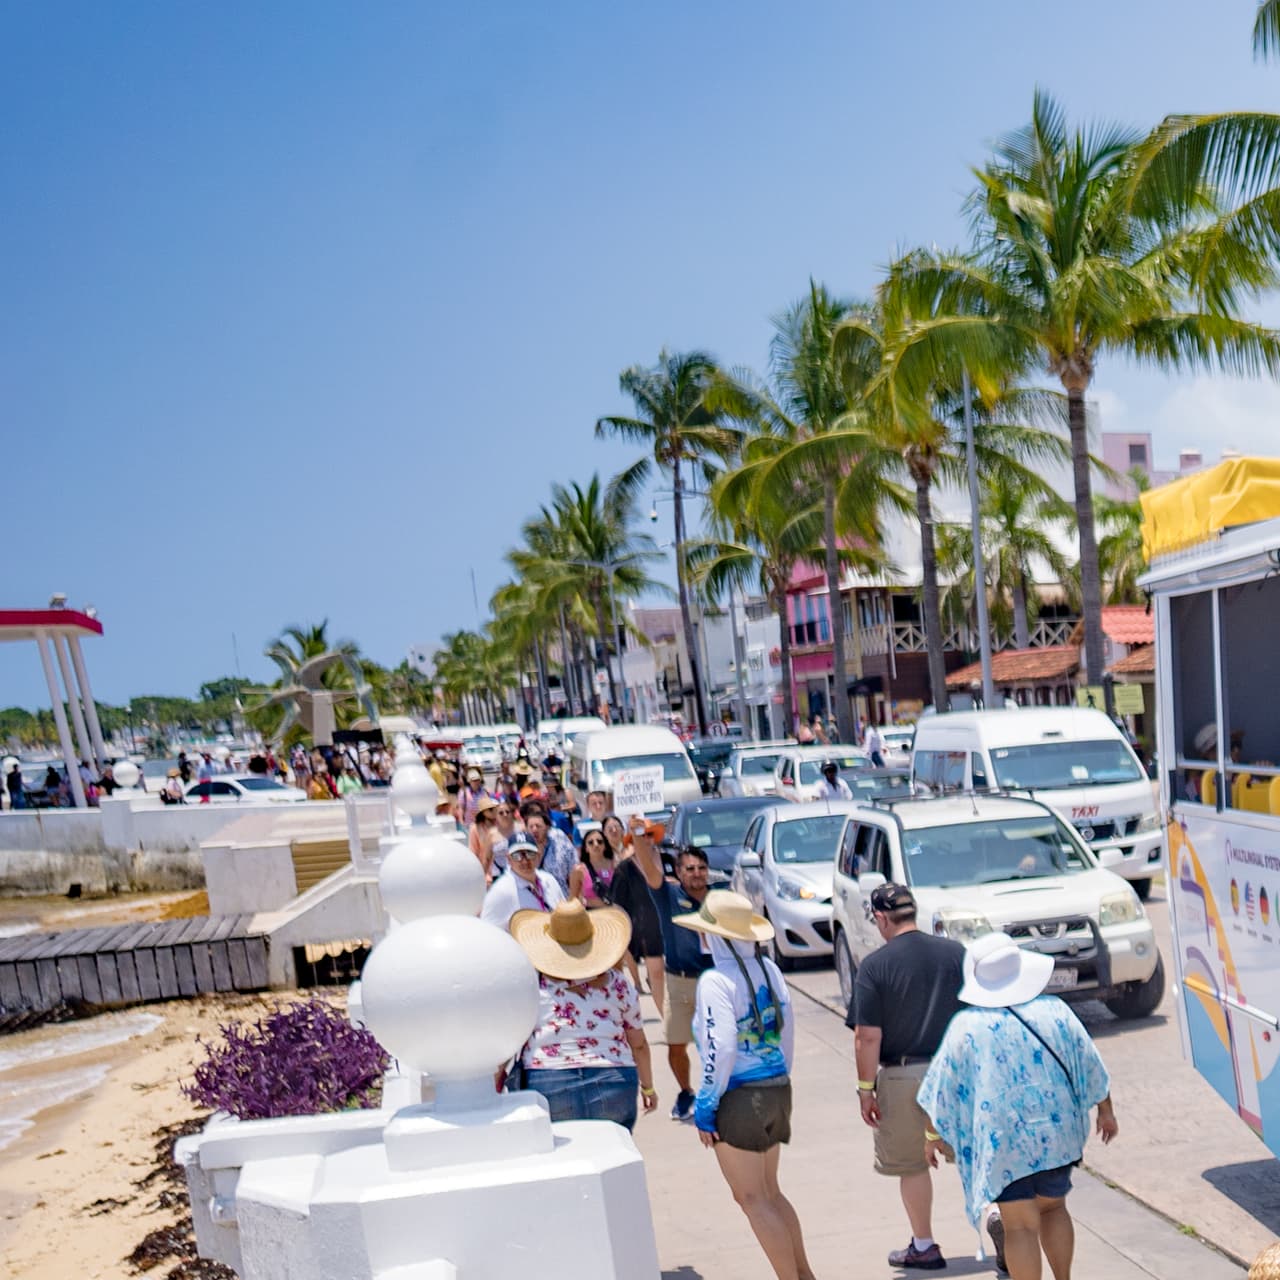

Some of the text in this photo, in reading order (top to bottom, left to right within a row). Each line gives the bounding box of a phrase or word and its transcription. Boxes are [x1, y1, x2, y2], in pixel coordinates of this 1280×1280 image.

[624, 780, 655, 794] OPEN TOP
[1071, 805, 1100, 818] TAXI
[1232, 847, 1264, 868] MULTILINGUAL
[704, 1006, 716, 1085] ISLANDS
